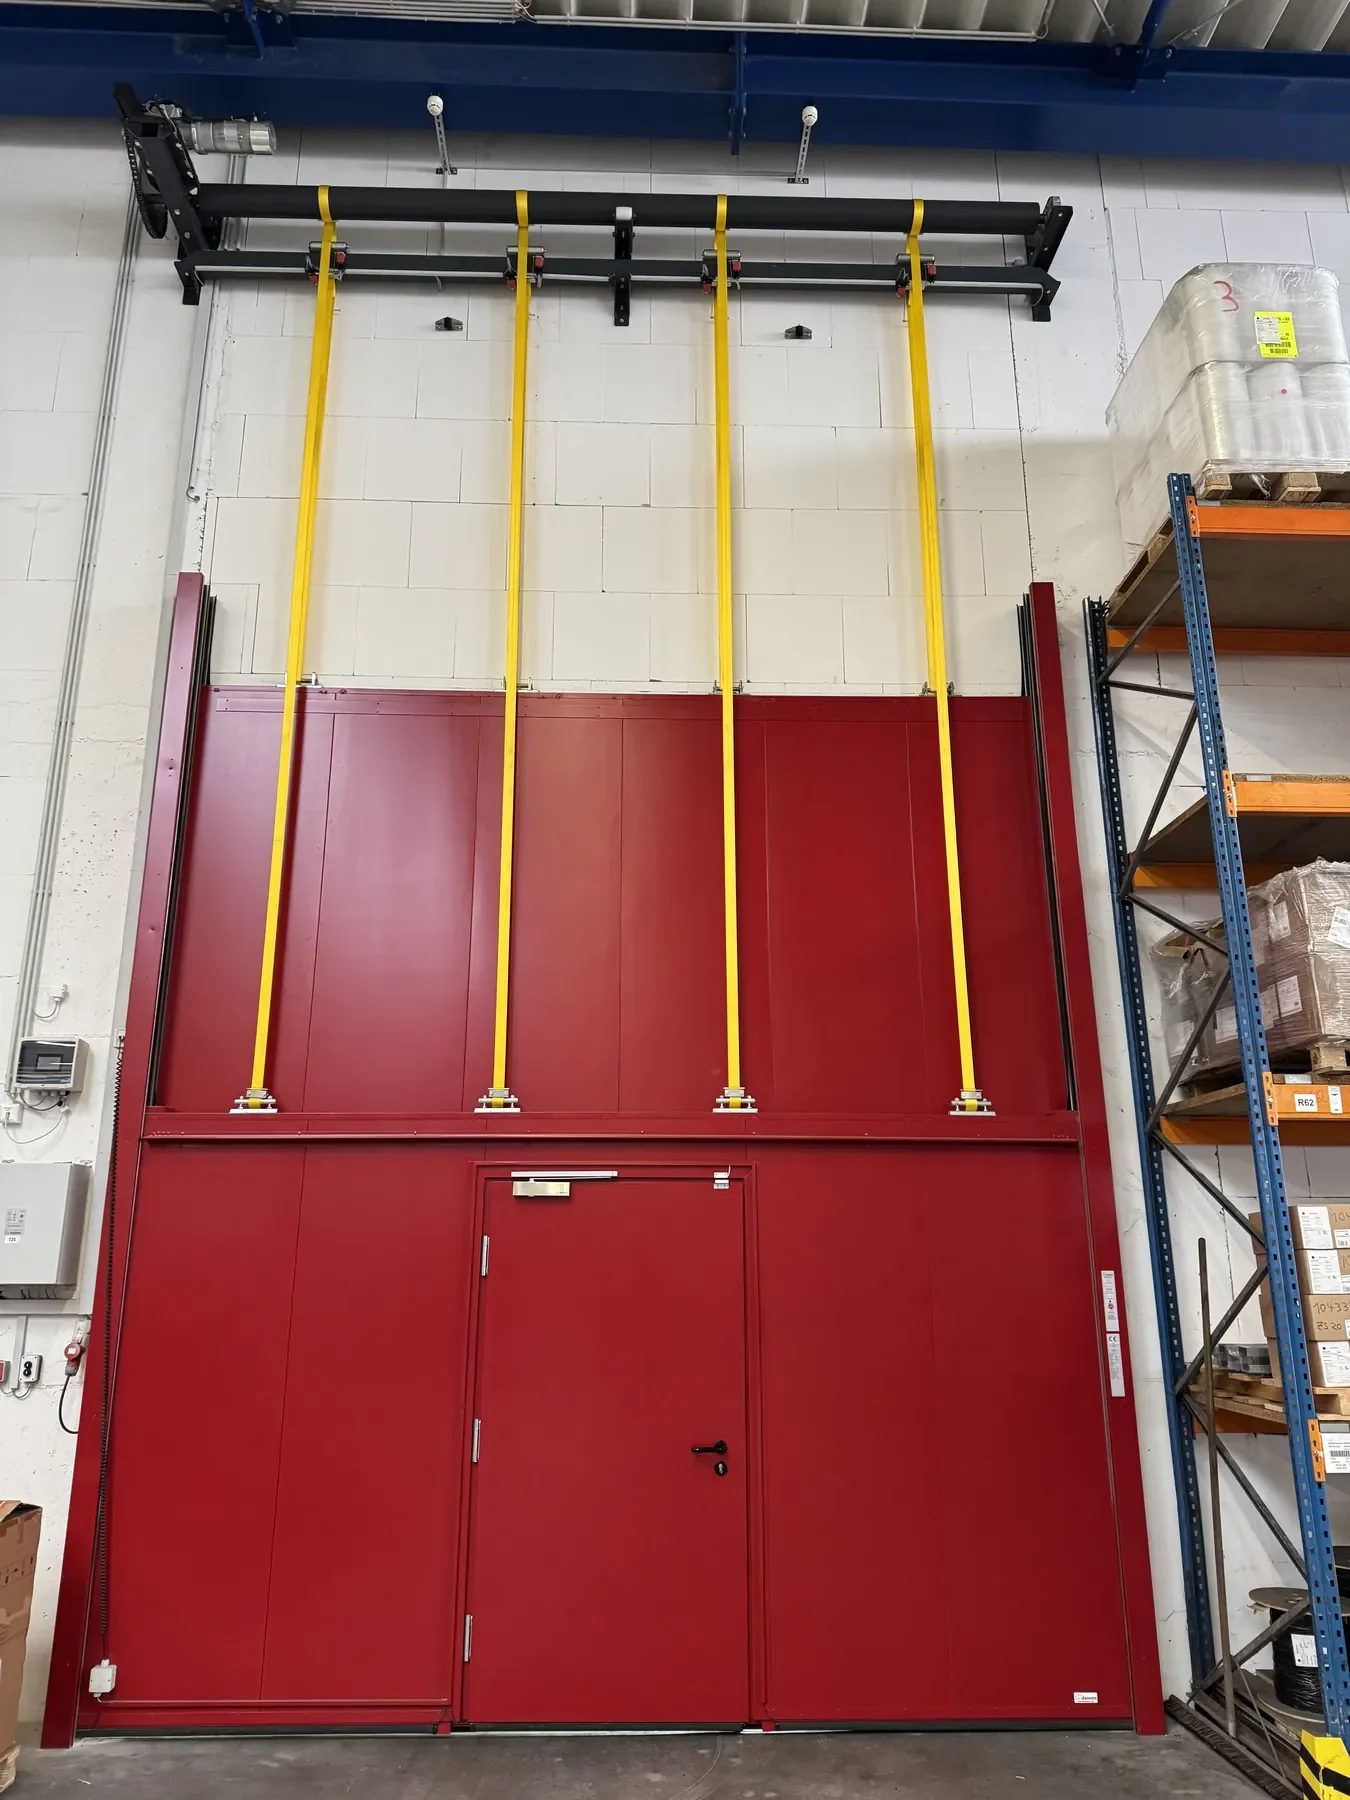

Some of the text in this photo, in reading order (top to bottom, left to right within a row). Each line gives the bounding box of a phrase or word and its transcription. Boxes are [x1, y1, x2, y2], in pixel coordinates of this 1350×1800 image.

[1213, 280, 1239, 312] 3
[1297, 1098, 1315, 1107] R62
[1312, 1301, 1350, 1314] 10433
